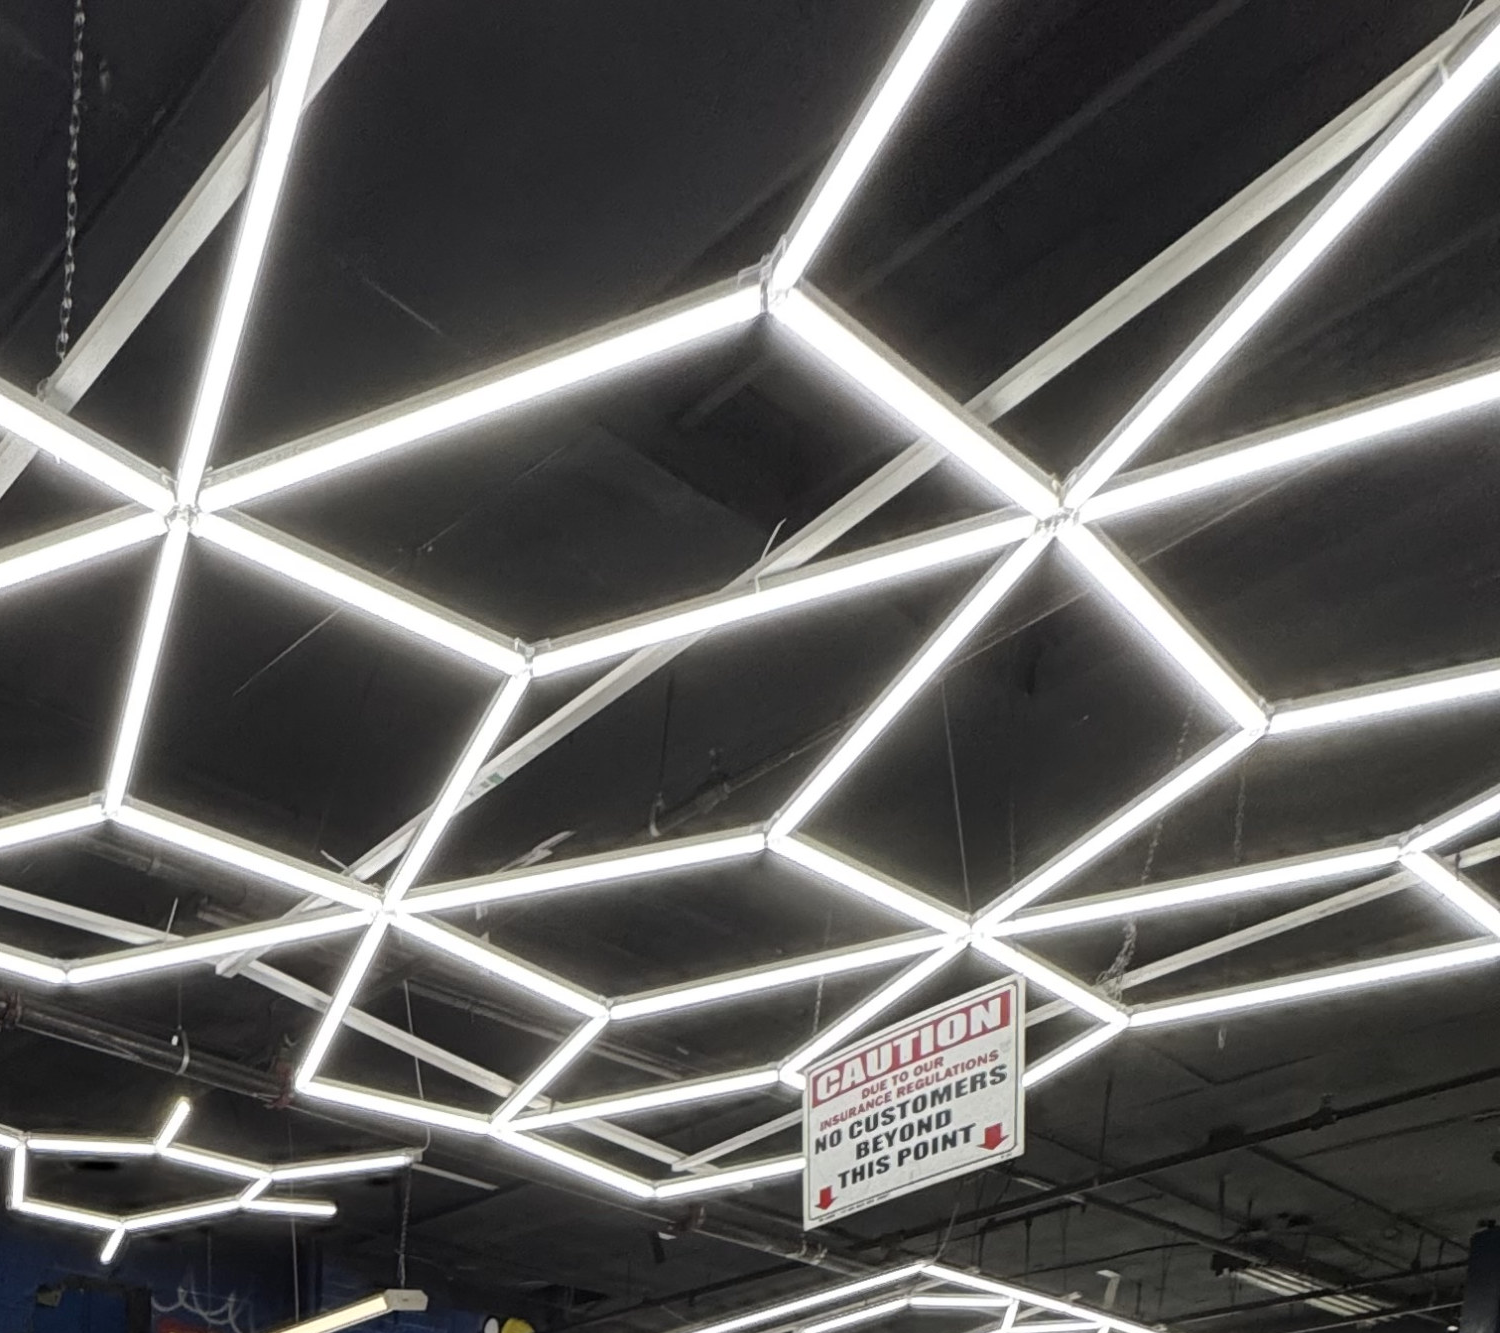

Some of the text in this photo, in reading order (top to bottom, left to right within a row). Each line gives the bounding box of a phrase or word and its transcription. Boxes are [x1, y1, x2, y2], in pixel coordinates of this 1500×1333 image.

[815, 997, 1003, 1102] CAUTION
[862, 1056, 944, 1100] DUE TO OUR
[814, 1064, 1008, 1155] NO CUSTOMERS
[820, 1050, 999, 1131] INSURANCE REGULATIONS
[838, 1123, 977, 1189] THIS POINT
[856, 1108, 952, 1160] BEYOND
